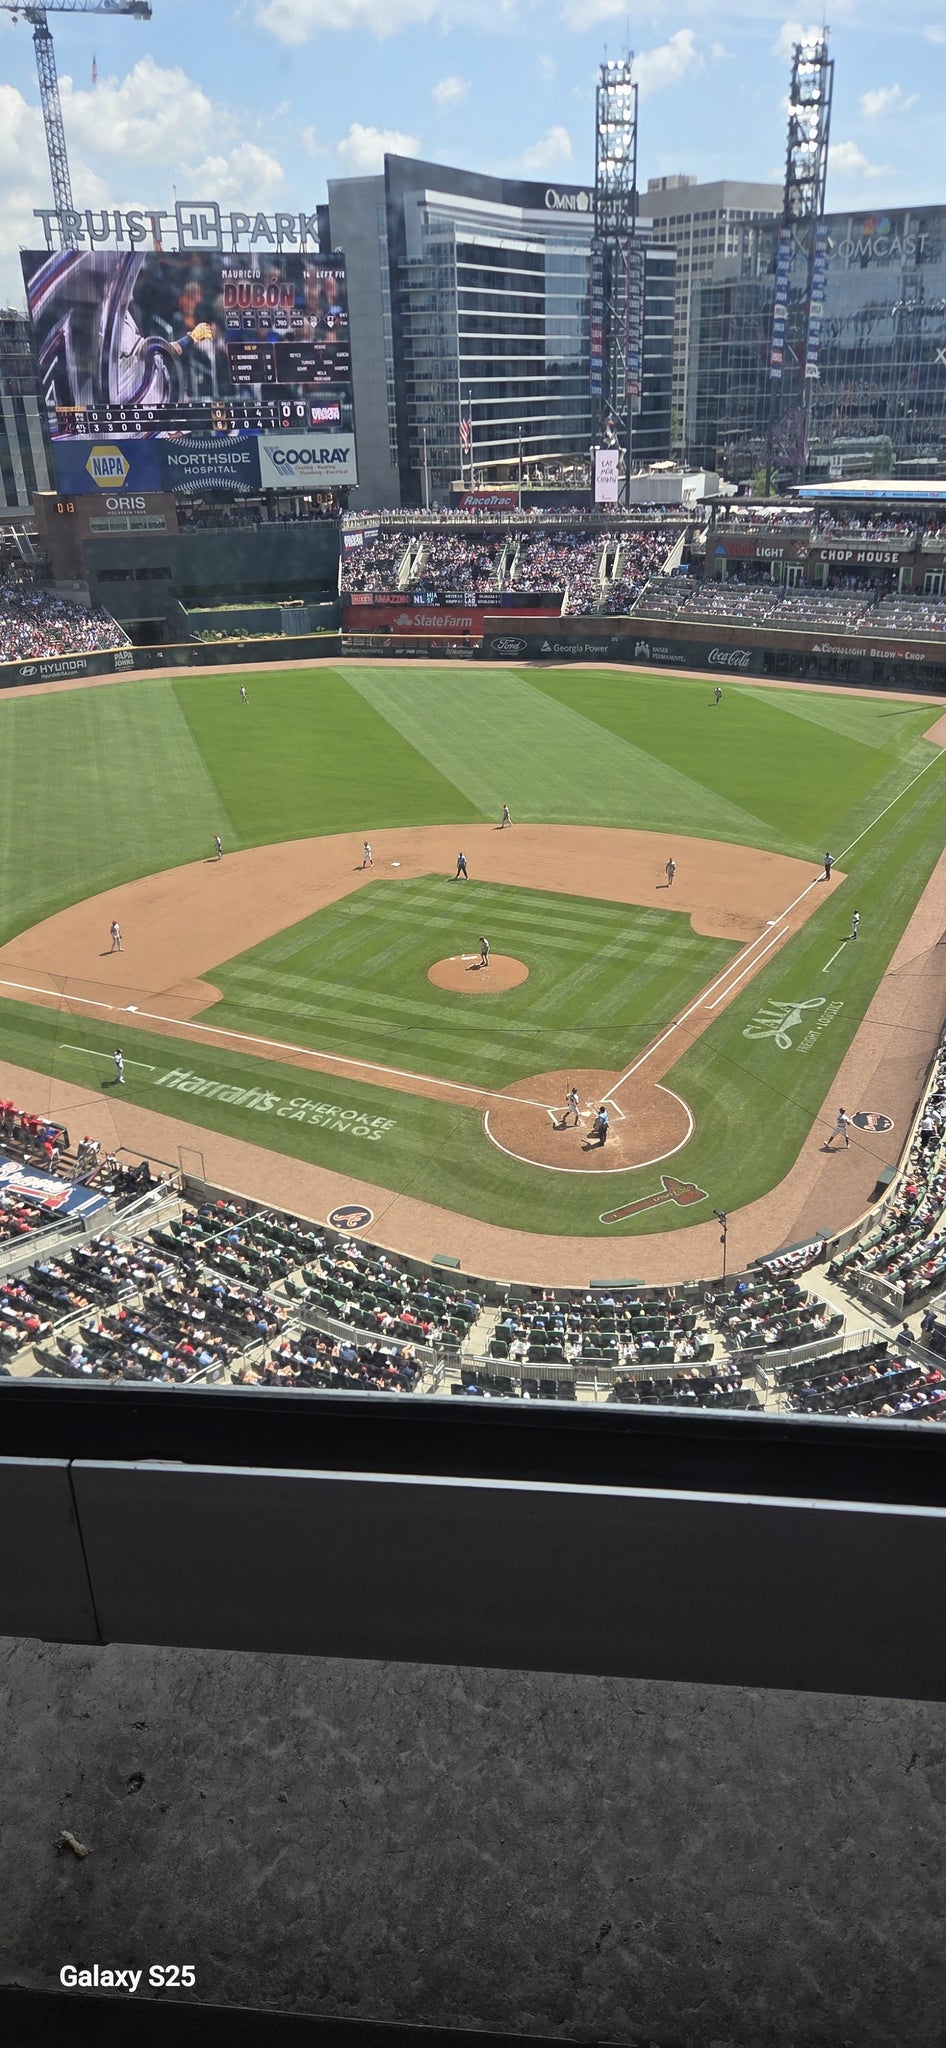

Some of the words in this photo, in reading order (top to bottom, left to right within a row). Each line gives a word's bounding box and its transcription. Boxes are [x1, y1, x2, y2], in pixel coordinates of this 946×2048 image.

[33, 208, 167, 243] TRUIST
[230, 211, 321, 244] PARK
[822, 232, 930, 260] COMCAST
[222, 270, 260, 279] MAURICIO
[223, 277, 295, 309] DUBÓN
[283, 406, 290, 417] 0
[296, 406, 304, 417] 0
[167, 453, 251, 466] NORTHSIDE
[272, 448, 350, 465] COOLRAY
[92, 457, 124, 476] NAPA
[184, 466, 237, 474] HOSPITAL
[106, 497, 146, 510] ORIS
[464, 495, 511, 506] RaceTrac
[756, 547, 784, 557] LIGHT
[820, 550, 852, 561] CHOP
[857, 552, 899, 563] HOUSE
[497, 640, 521, 650] Ford
[553, 644, 582, 654] Georgia
[584, 644, 609, 652] Power
[114, 651, 133, 660] PAPA
[652, 653, 686, 662] PERMANENTE
[708, 647, 752, 667] Coca-Cola
[870, 648, 896, 658] BELOW
[905, 651, 926, 661] CHOP
[40, 659, 87, 674] HYUNDAI
[115, 658, 134, 667] JOHNS
[154, 1067, 281, 1112] Harrah's
[289, 1097, 397, 1131] CHEROKEE
[276, 1107, 385, 1141] CASINOS
